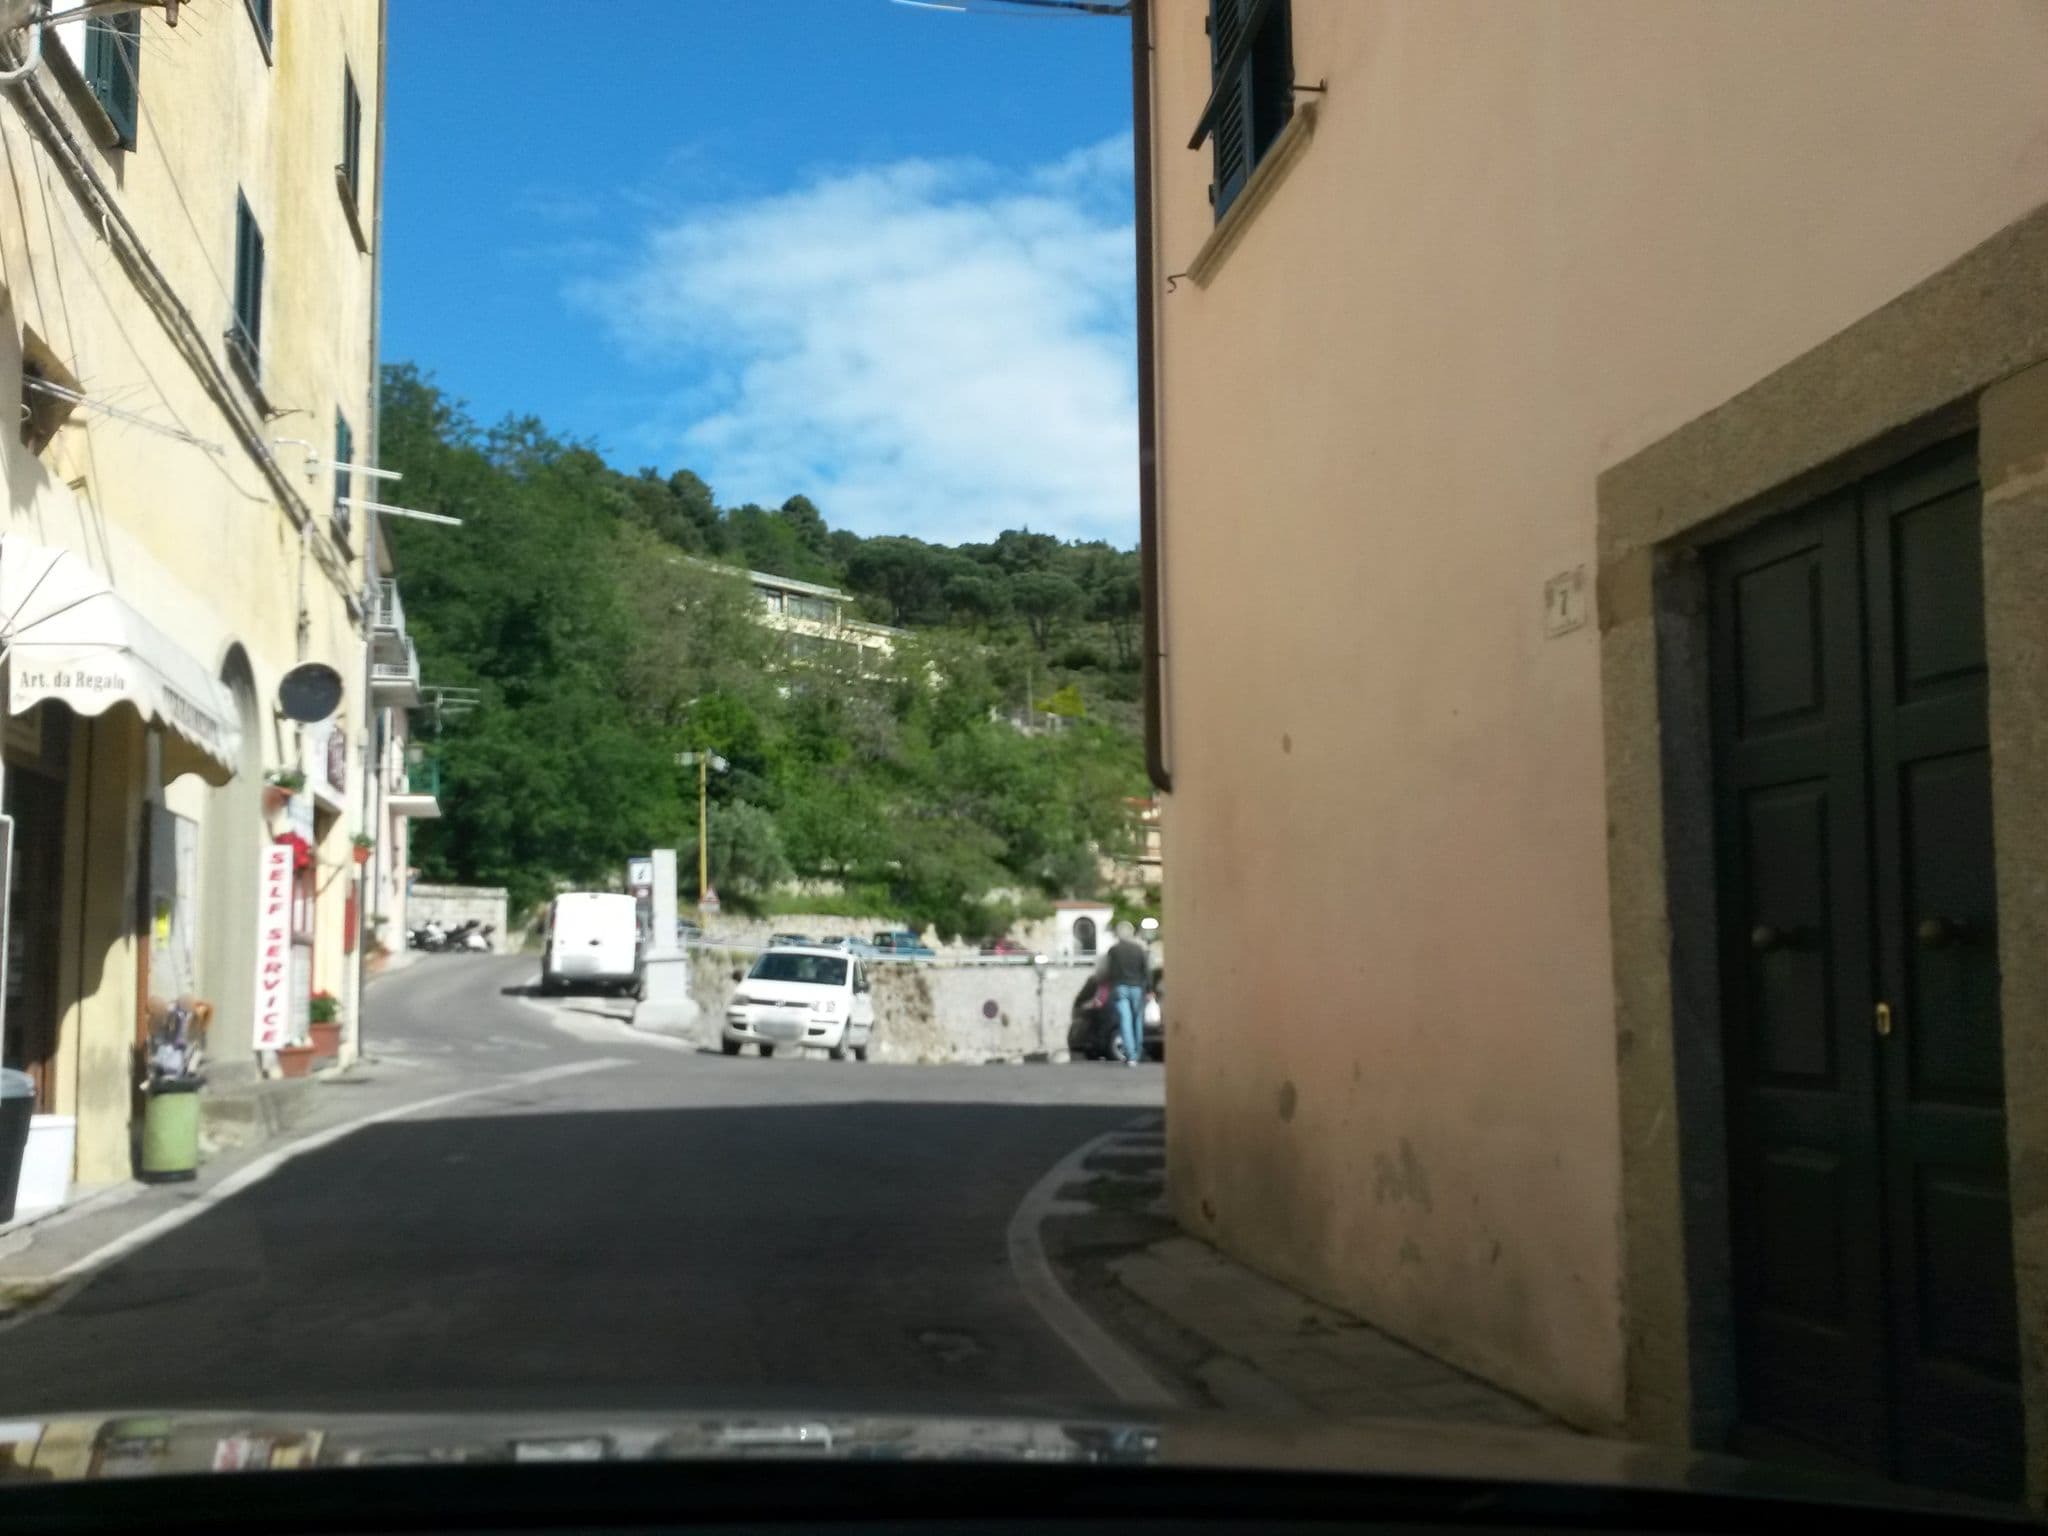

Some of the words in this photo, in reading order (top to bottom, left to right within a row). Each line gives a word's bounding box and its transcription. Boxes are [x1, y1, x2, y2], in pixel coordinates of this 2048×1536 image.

[20, 671, 49, 689] Art.
[54, 670, 71, 689] da
[75, 671, 127, 693] Regalo
[267, 852, 285, 914] SELF
[262, 927, 283, 1043] SERVICE
